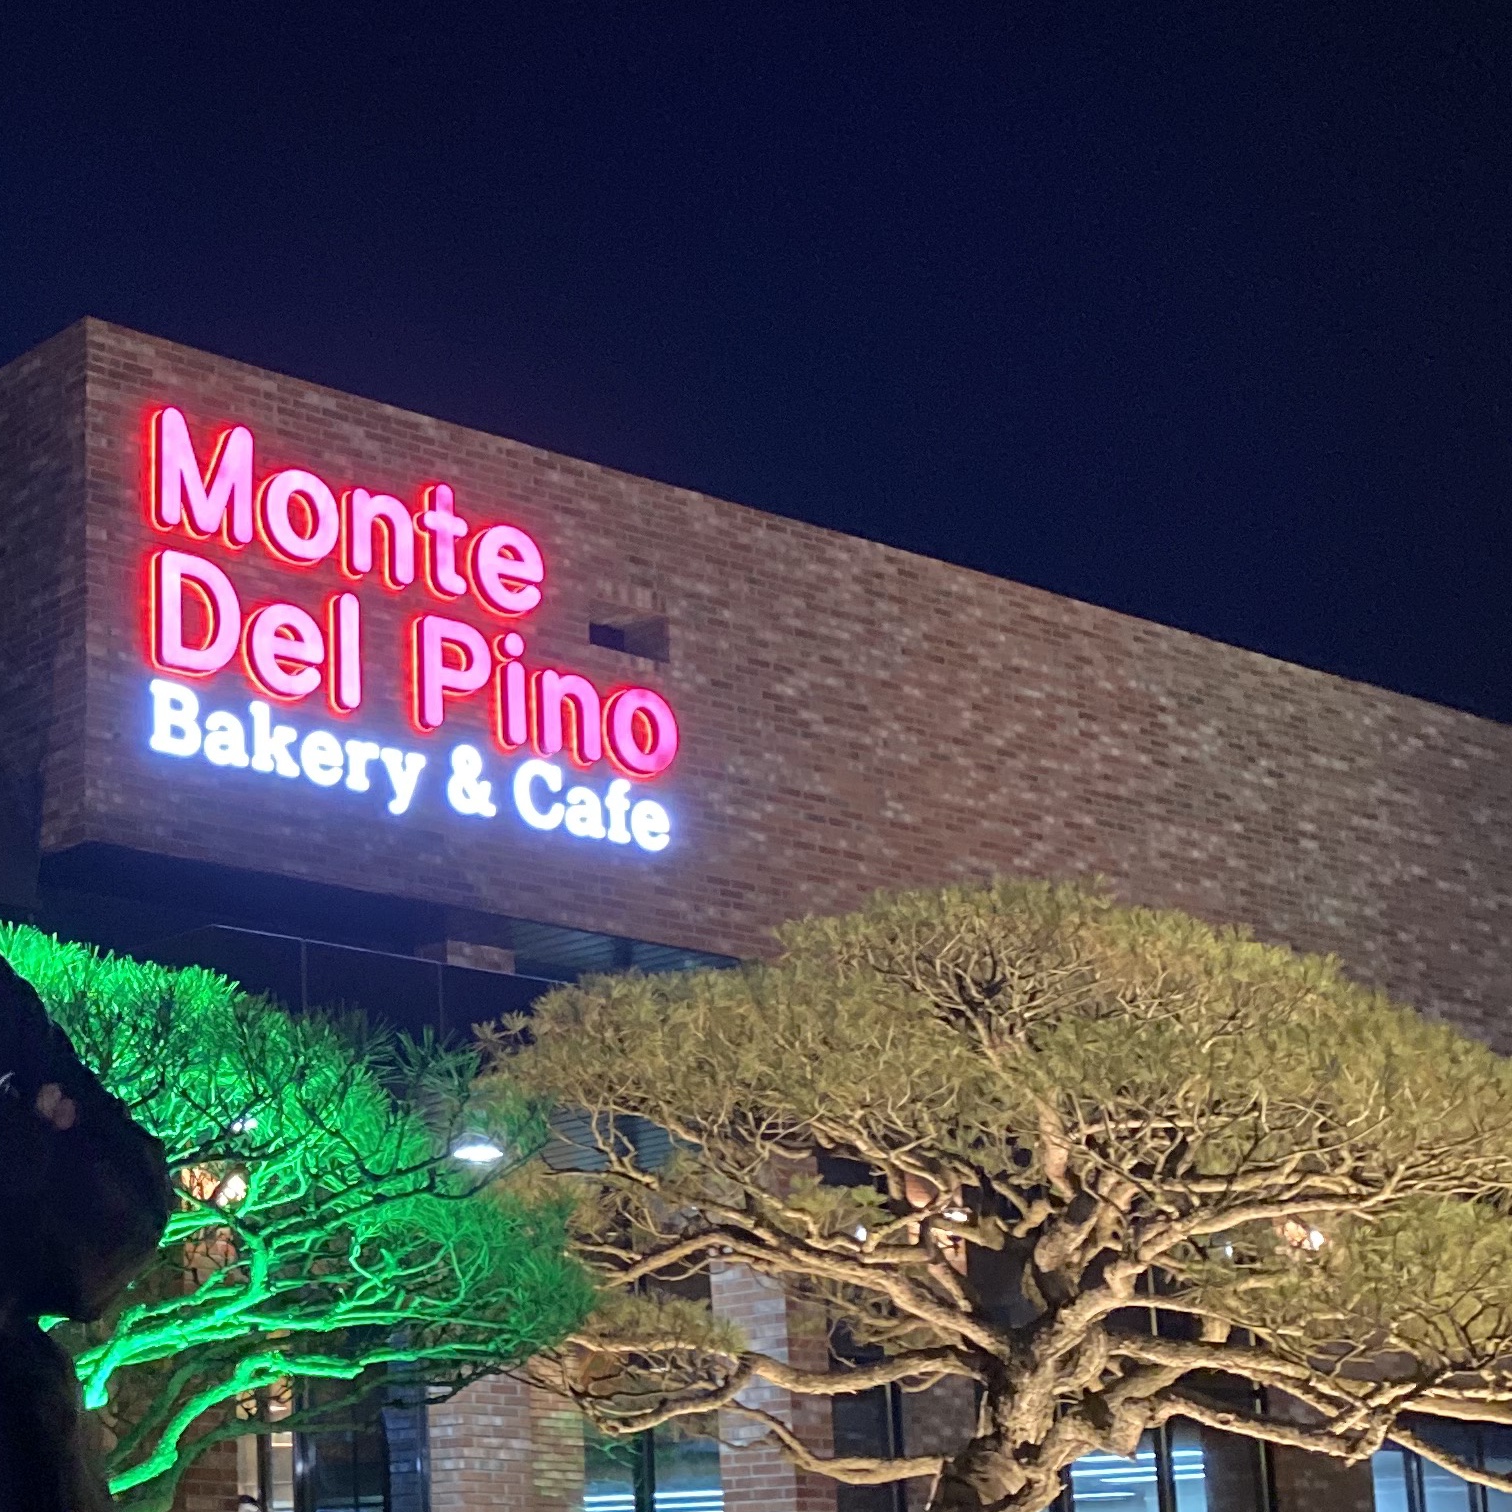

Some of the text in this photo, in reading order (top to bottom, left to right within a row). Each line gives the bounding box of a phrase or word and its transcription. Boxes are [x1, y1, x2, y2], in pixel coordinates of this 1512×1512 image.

[151, 406, 545, 615] Monte
[149, 678, 672, 851] Bakery & Cafe
[151, 548, 680, 777] Del Pino
